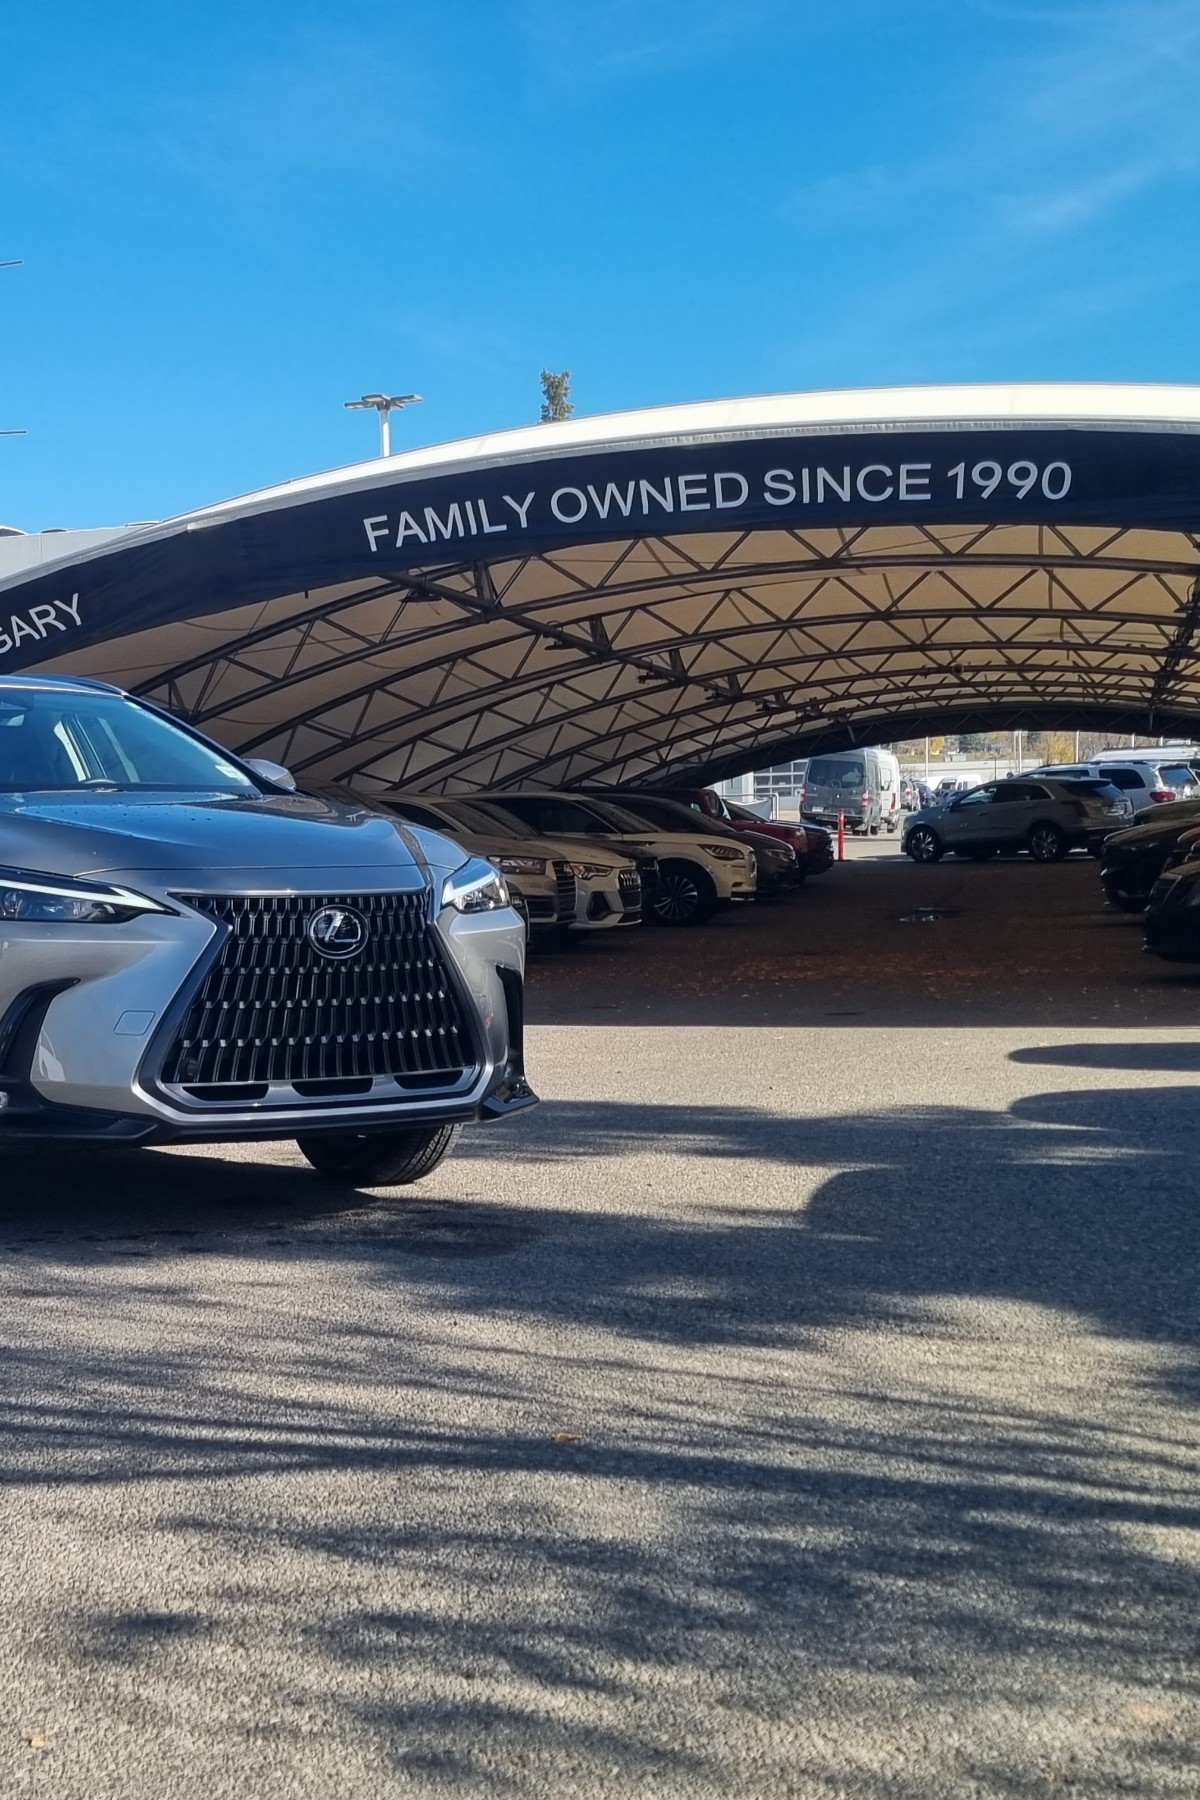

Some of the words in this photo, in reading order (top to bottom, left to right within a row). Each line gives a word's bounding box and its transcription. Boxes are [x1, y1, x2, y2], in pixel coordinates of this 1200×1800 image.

[363, 492, 536, 552] FAMILY
[550, 472, 749, 523] OWNED
[763, 463, 933, 505] SINCE
[946, 461, 1073, 500] 1990
